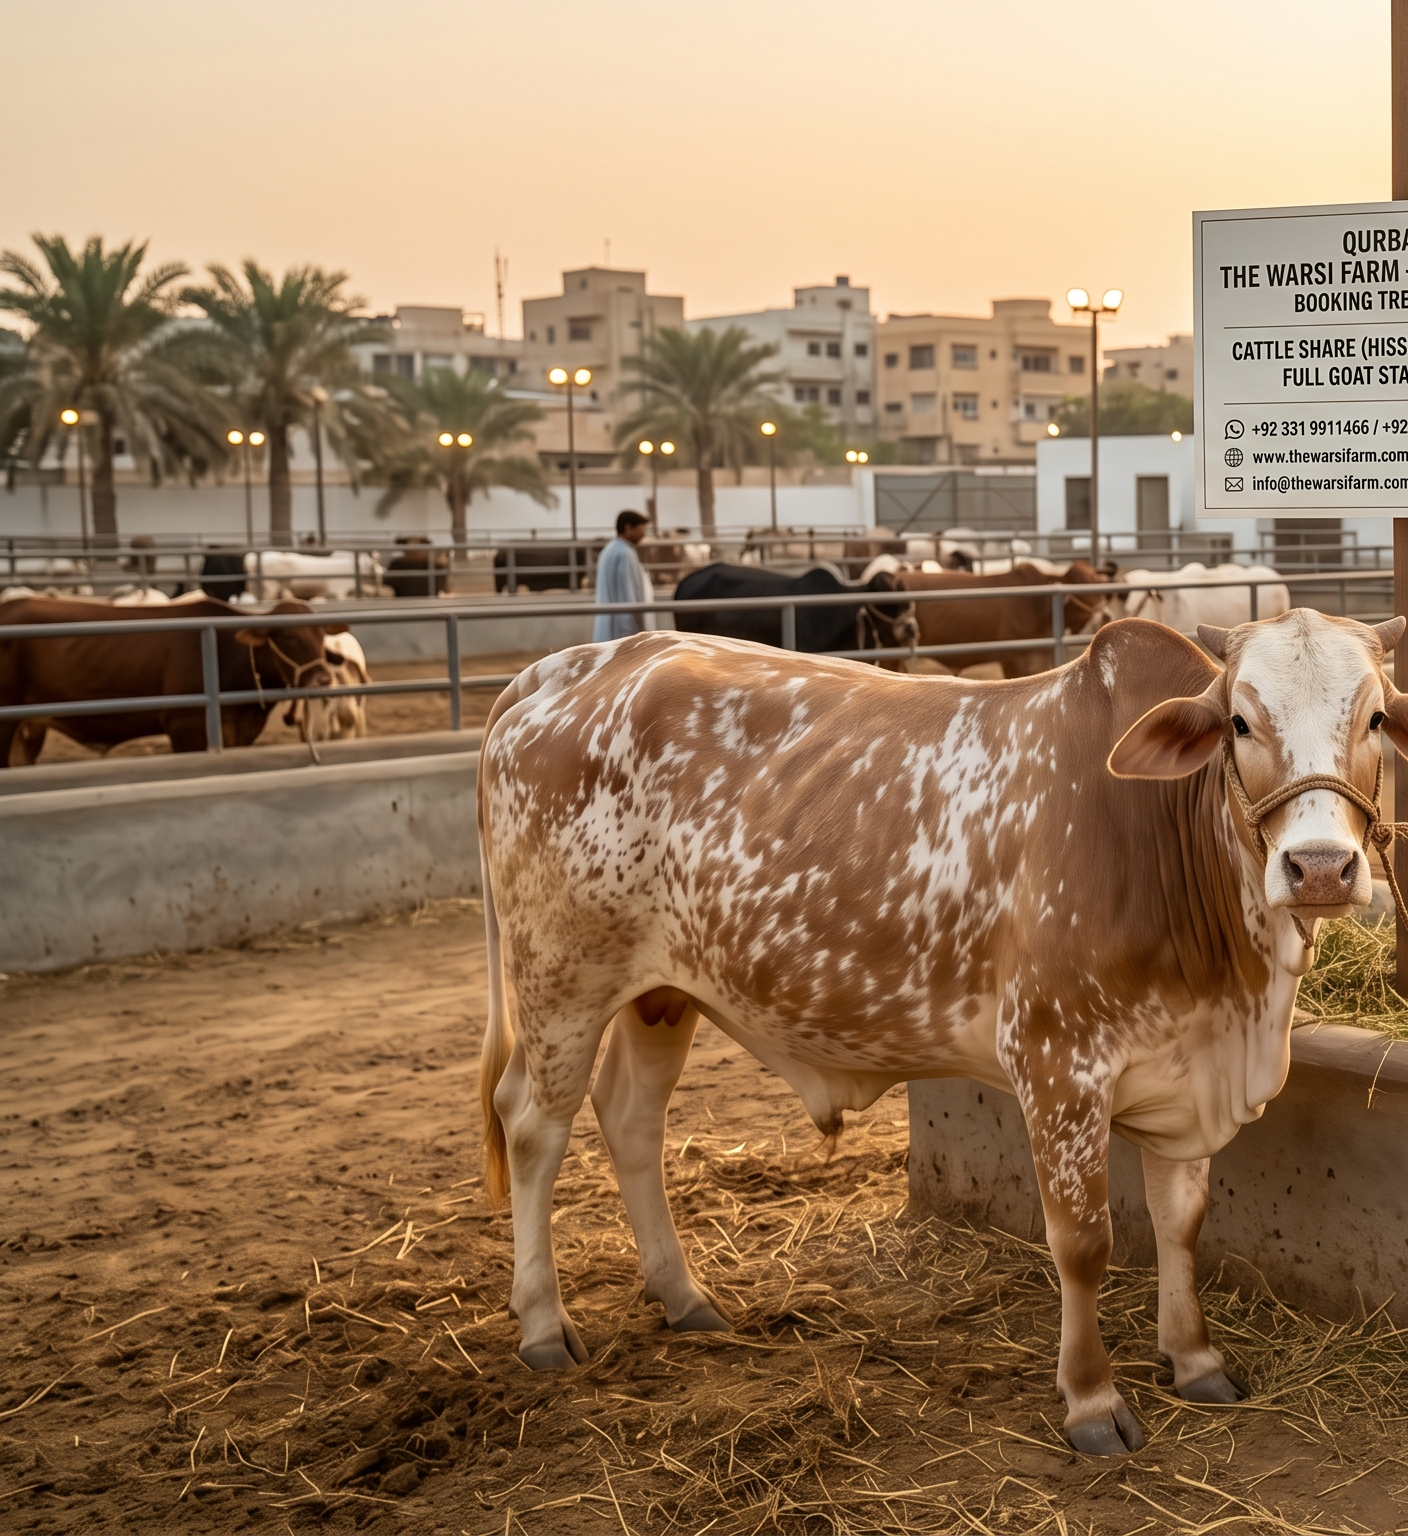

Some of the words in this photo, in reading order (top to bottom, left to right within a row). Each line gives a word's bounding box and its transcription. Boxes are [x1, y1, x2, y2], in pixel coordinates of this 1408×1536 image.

[1219, 264, 1261, 289] THE
[1265, 261, 1333, 287] WARSI
[1340, 258, 1400, 285] FARM
[1294, 290, 1373, 313] BOOKING
[1232, 339, 1295, 361] CATTLE
[1298, 338, 1357, 359] SHARE
[1283, 366, 1325, 387] FULL
[1328, 365, 1375, 386] GOAT
[1251, 421, 1278, 437] +92
[1281, 420, 1305, 437] 331
[1309, 419, 1370, 436] 9911466
[1372, 418, 1379, 436] /
[1382, 418, 1408, 435] +92
